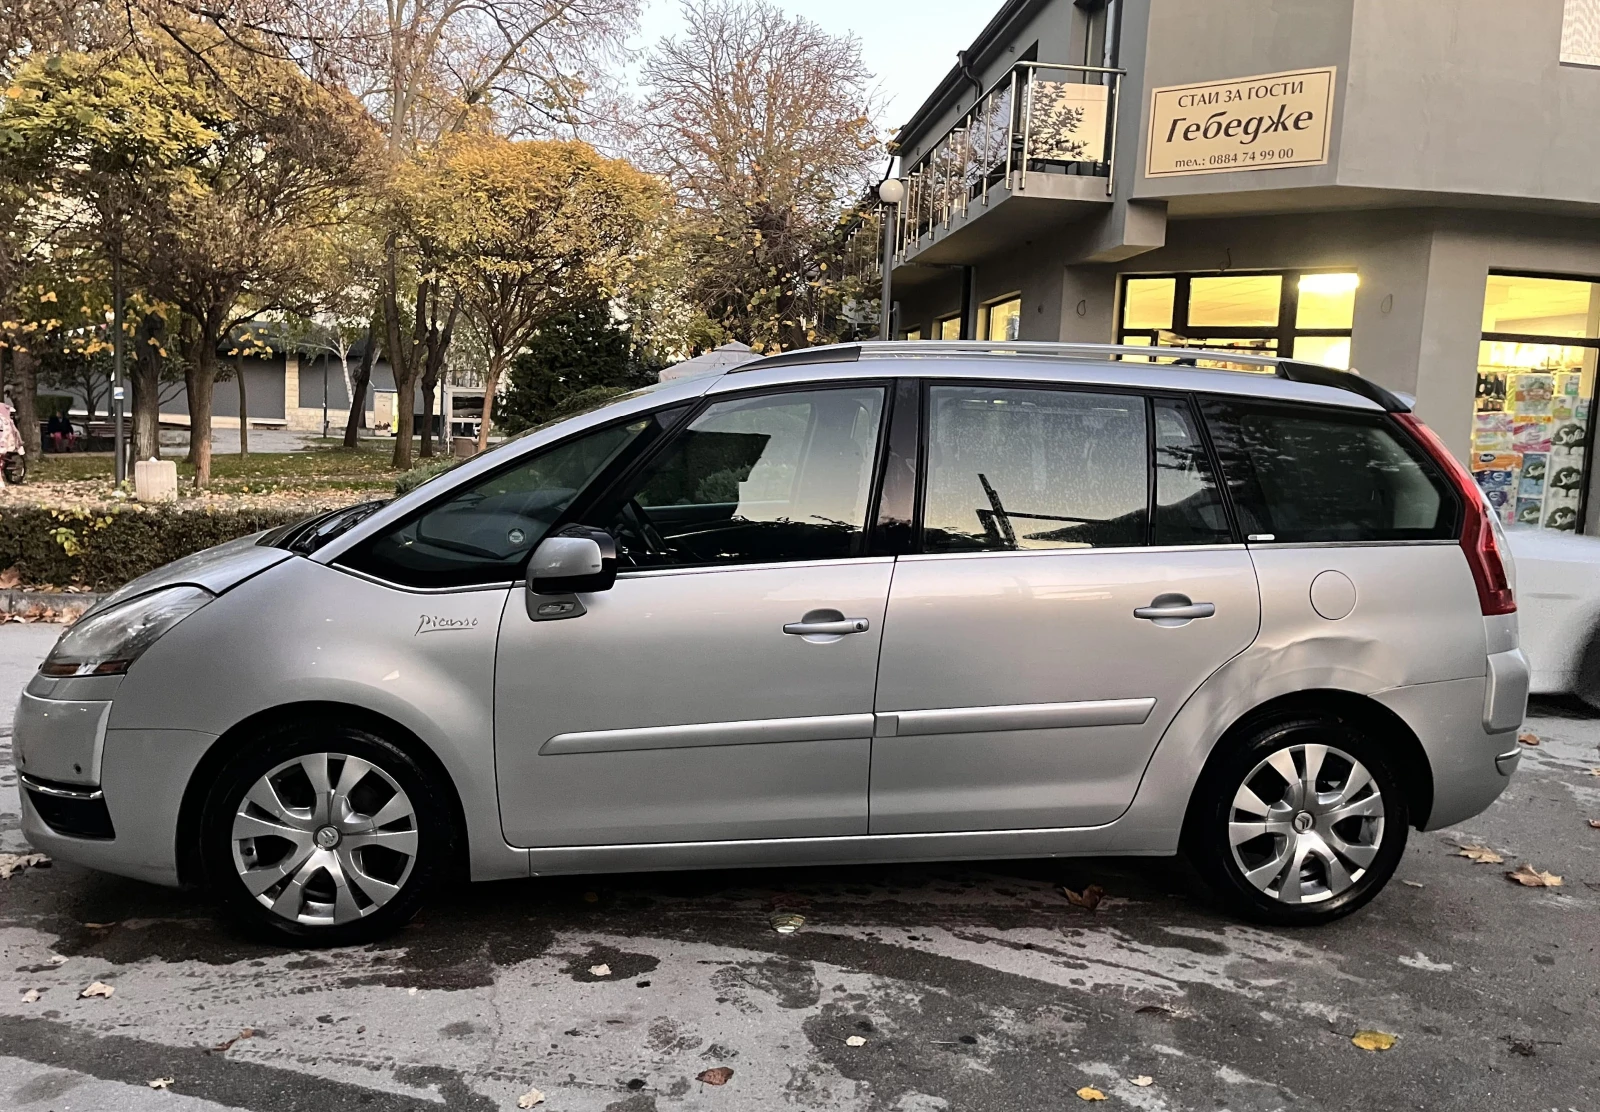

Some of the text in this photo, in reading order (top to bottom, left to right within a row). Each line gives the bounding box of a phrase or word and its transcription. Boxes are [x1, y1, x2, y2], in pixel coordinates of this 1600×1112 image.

[1178, 81, 1304, 108] СТАИ ЗА ГОСТИ
[1166, 104, 1314, 145] Гебедже
[1209, 153, 1238, 165] 0884
[1242, 151, 1256, 162] 74
[1260, 149, 1275, 161] 99
[1278, 148, 1294, 159] 00
[414, 614, 479, 637] Picasso
